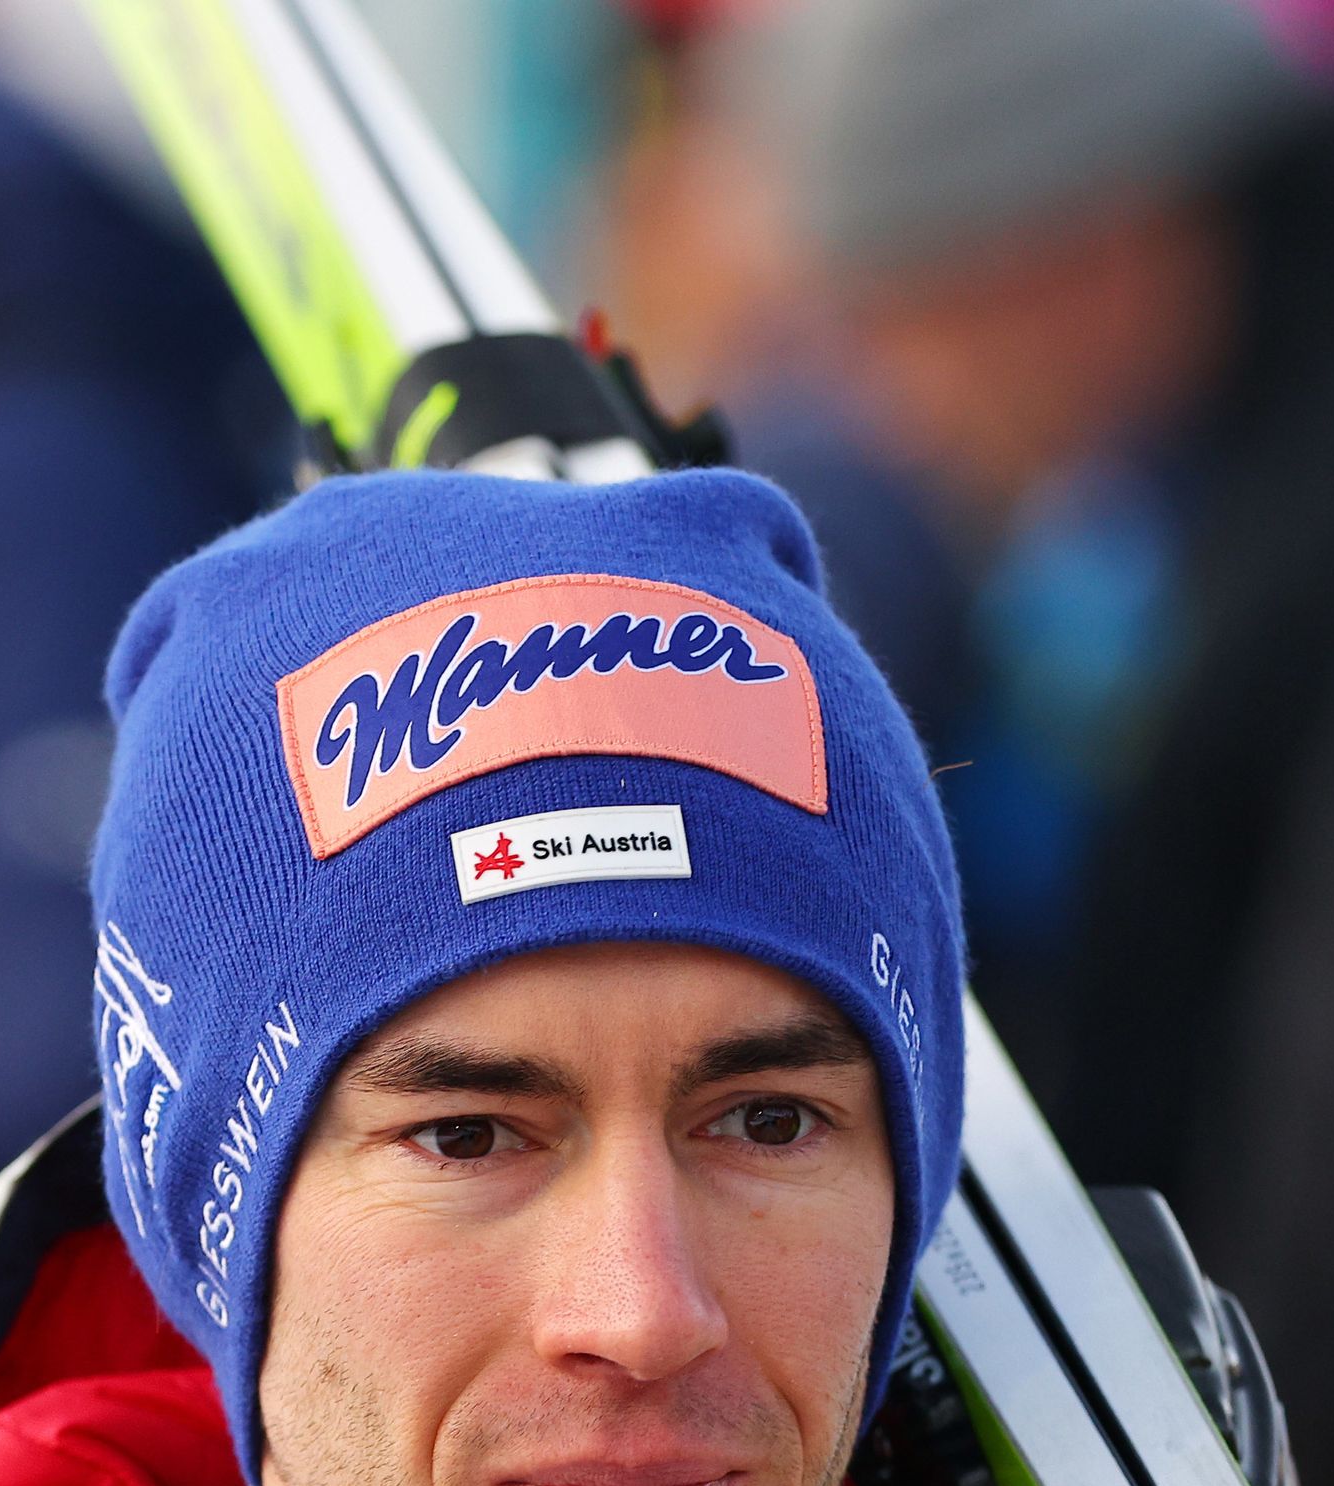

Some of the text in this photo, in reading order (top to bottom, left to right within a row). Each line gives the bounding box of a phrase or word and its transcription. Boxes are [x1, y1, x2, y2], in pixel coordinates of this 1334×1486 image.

[316, 612, 787, 808] Manner
[531, 830, 673, 861] Ski Austria
[195, 1001, 302, 1328] GIESSWEIN
